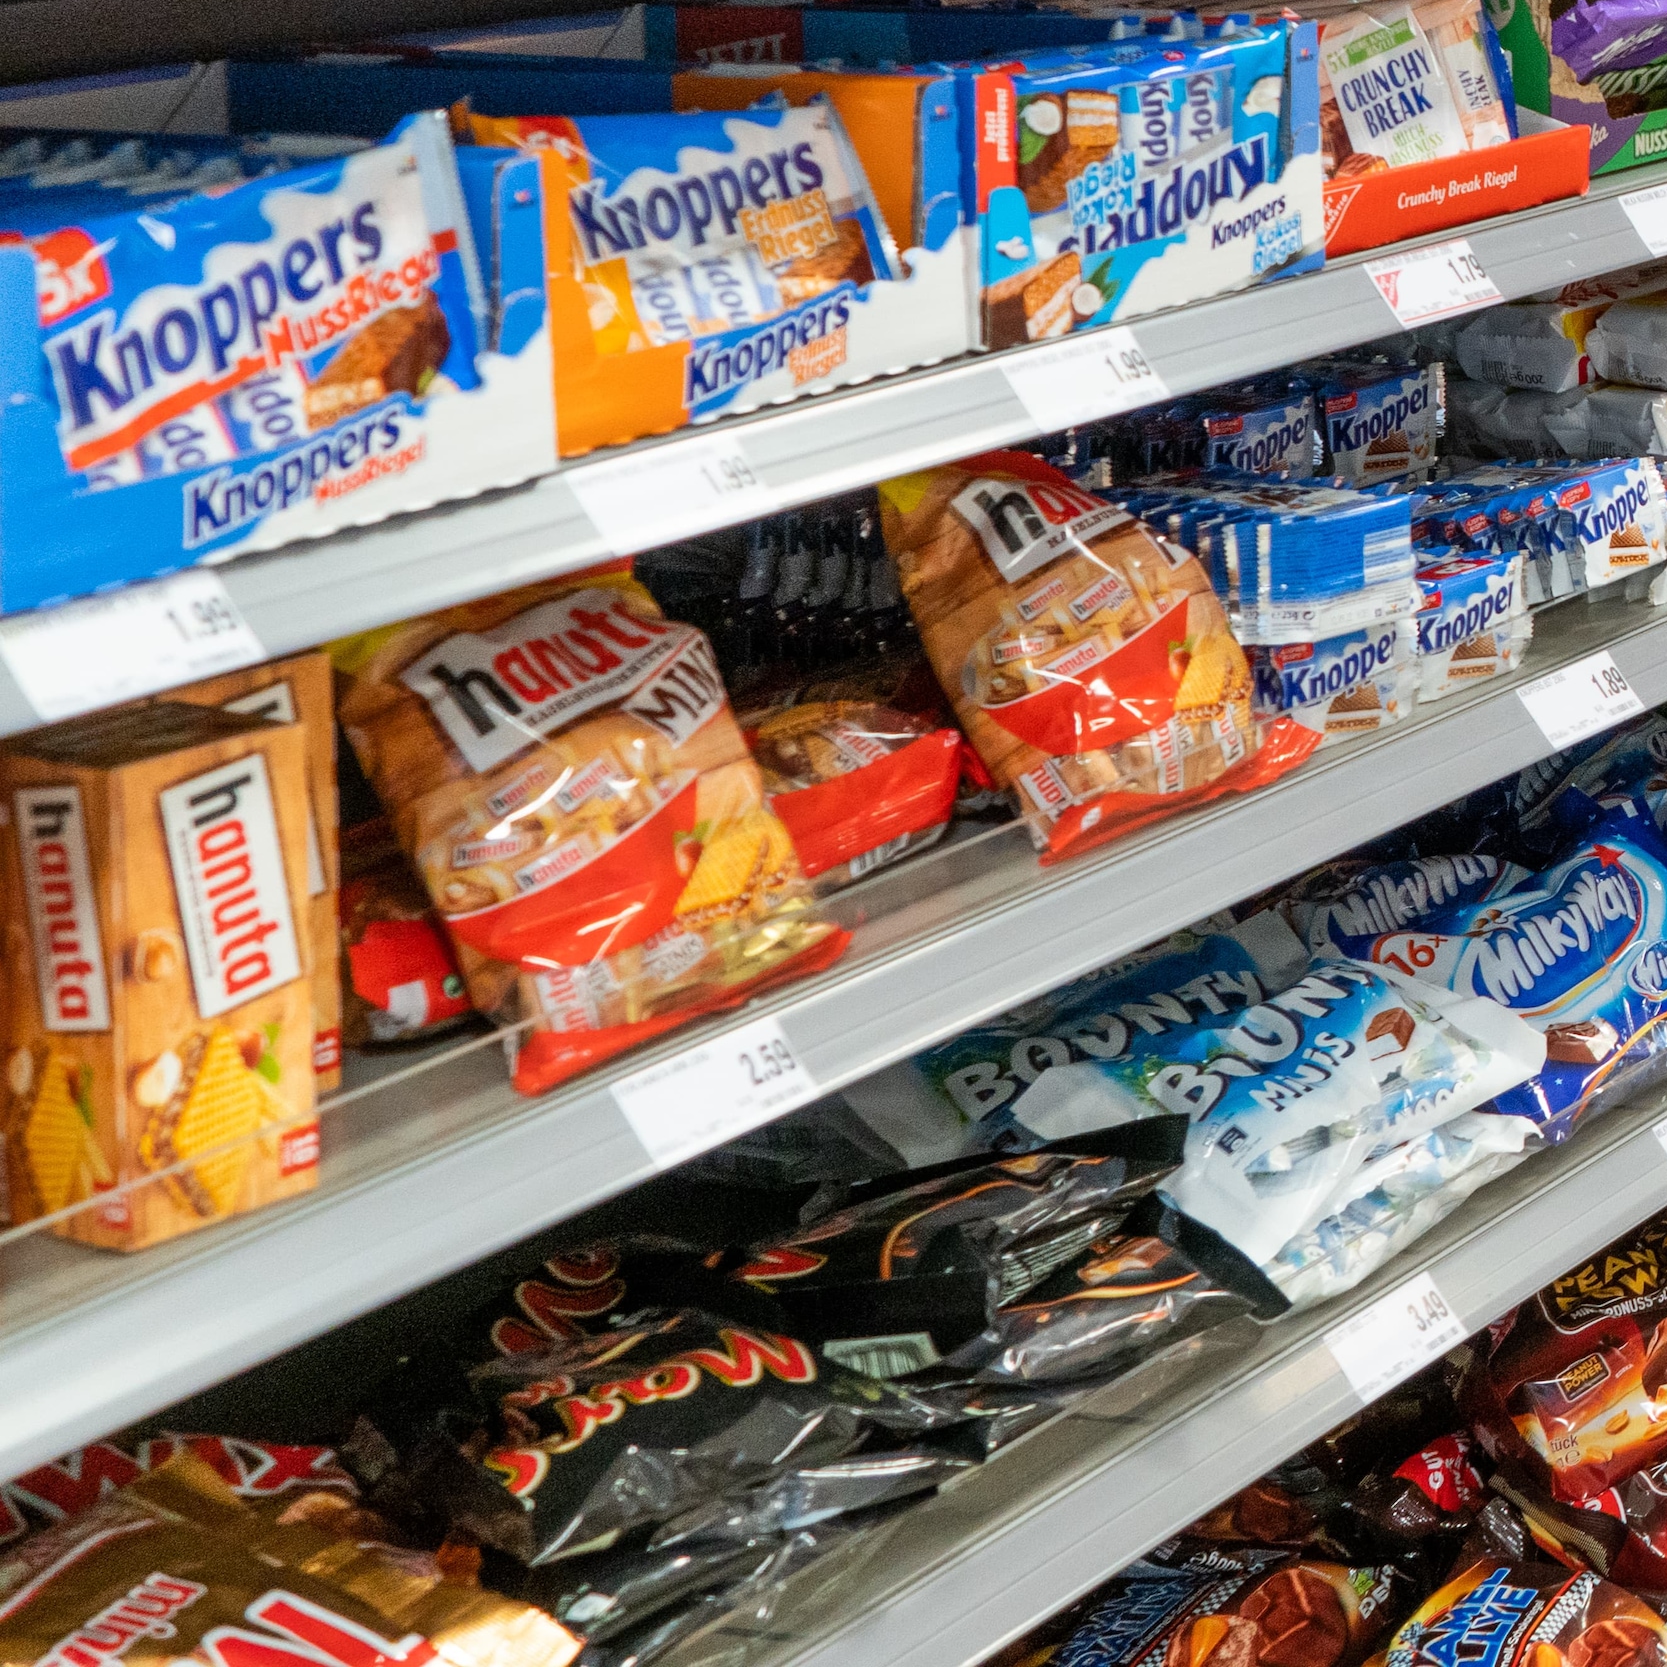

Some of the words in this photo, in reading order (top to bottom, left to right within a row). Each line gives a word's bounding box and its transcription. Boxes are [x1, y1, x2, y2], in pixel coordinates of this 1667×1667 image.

[1341, 46, 1434, 114] CRUNCHY
[1364, 85, 1433, 141] BREAK
[569, 138, 824, 263] Knoppers
[1398, 176, 1445, 211] Crunchy
[1448, 172, 1482, 201] Break
[1483, 164, 1518, 193] Riegel
[1211, 192, 1288, 250] Knoppers
[1448, 253, 1486, 284] 1.79
[45, 194, 383, 434] Knoppers
[684, 291, 853, 408] Knoppers
[1105, 348, 1152, 384] 1.99
[183, 407, 401, 544] Knoppers
[1592, 666, 1629, 699] 1.89
[29, 798, 94, 1023] hanuta
[188, 773, 275, 998] hanuta
[1472, 869, 1642, 1009] MilkyWay
[739, 1038, 795, 1087] 2.59
[1406, 1291, 1449, 1334] 3.49
